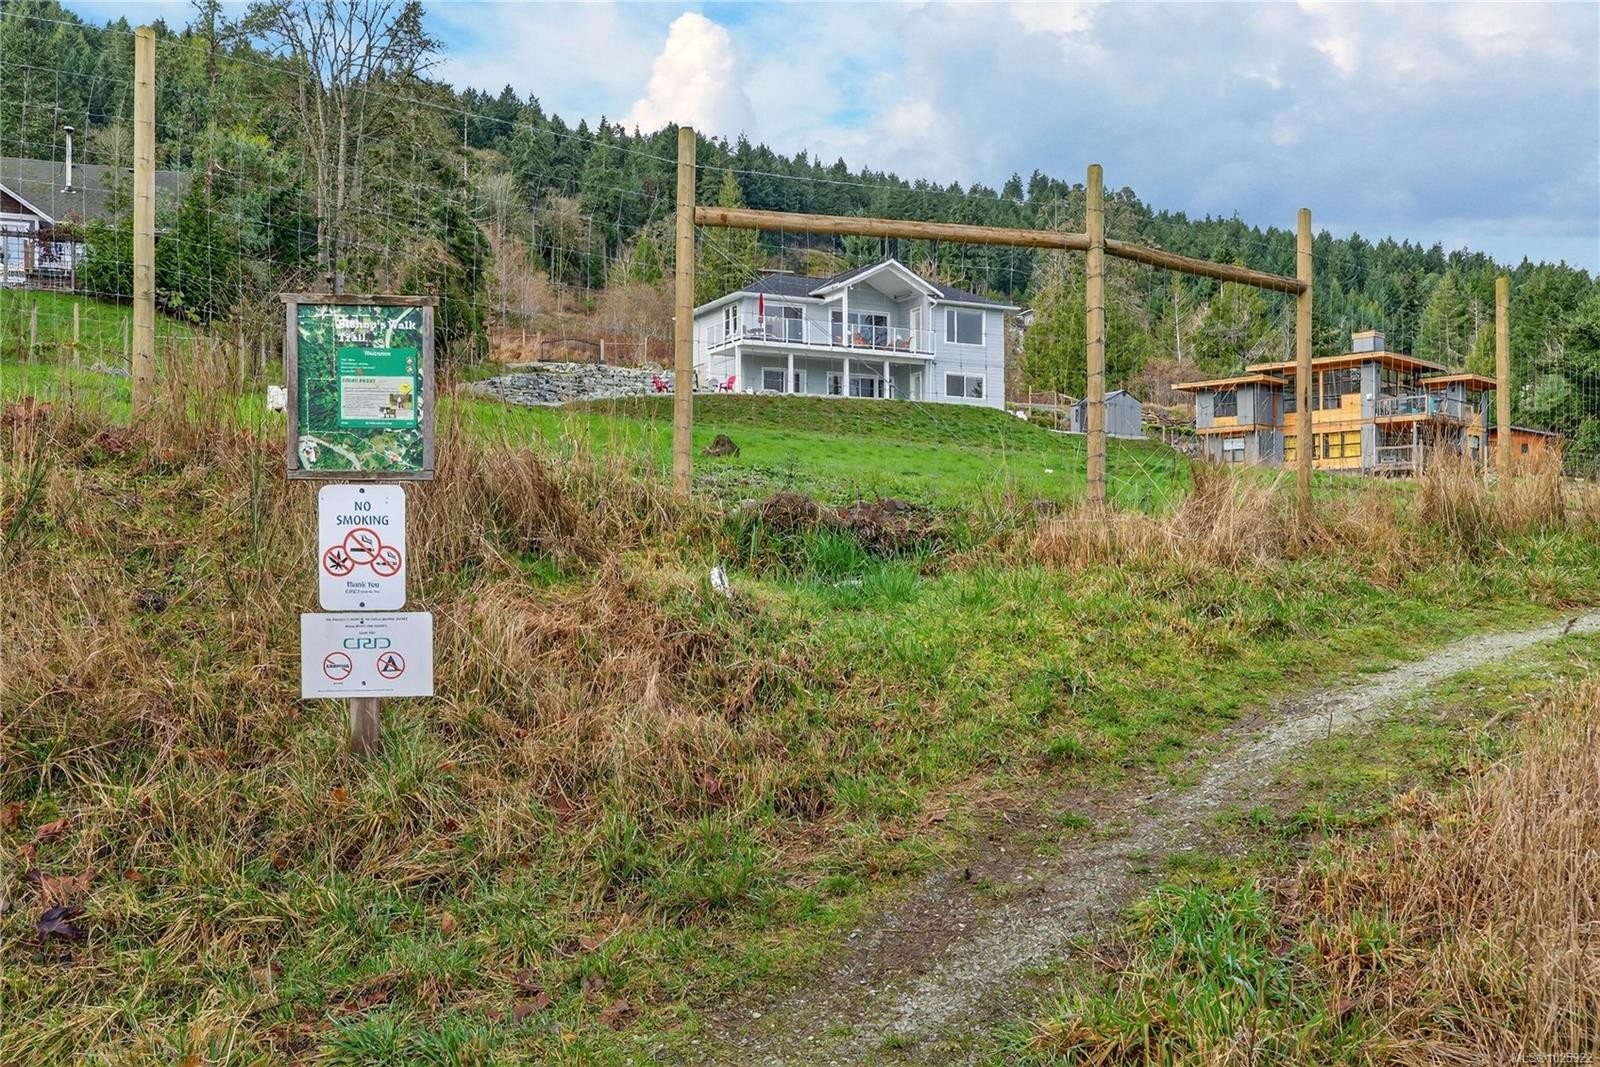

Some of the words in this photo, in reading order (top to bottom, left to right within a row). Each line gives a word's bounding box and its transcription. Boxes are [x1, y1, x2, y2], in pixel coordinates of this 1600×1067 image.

[338, 318, 387, 331] Bishop's
[388, 320, 416, 330] Walk
[338, 333, 366, 342] Trail
[354, 501, 372, 512] NO
[336, 514, 389, 526] SMOKING
[343, 637, 391, 649] CRD
